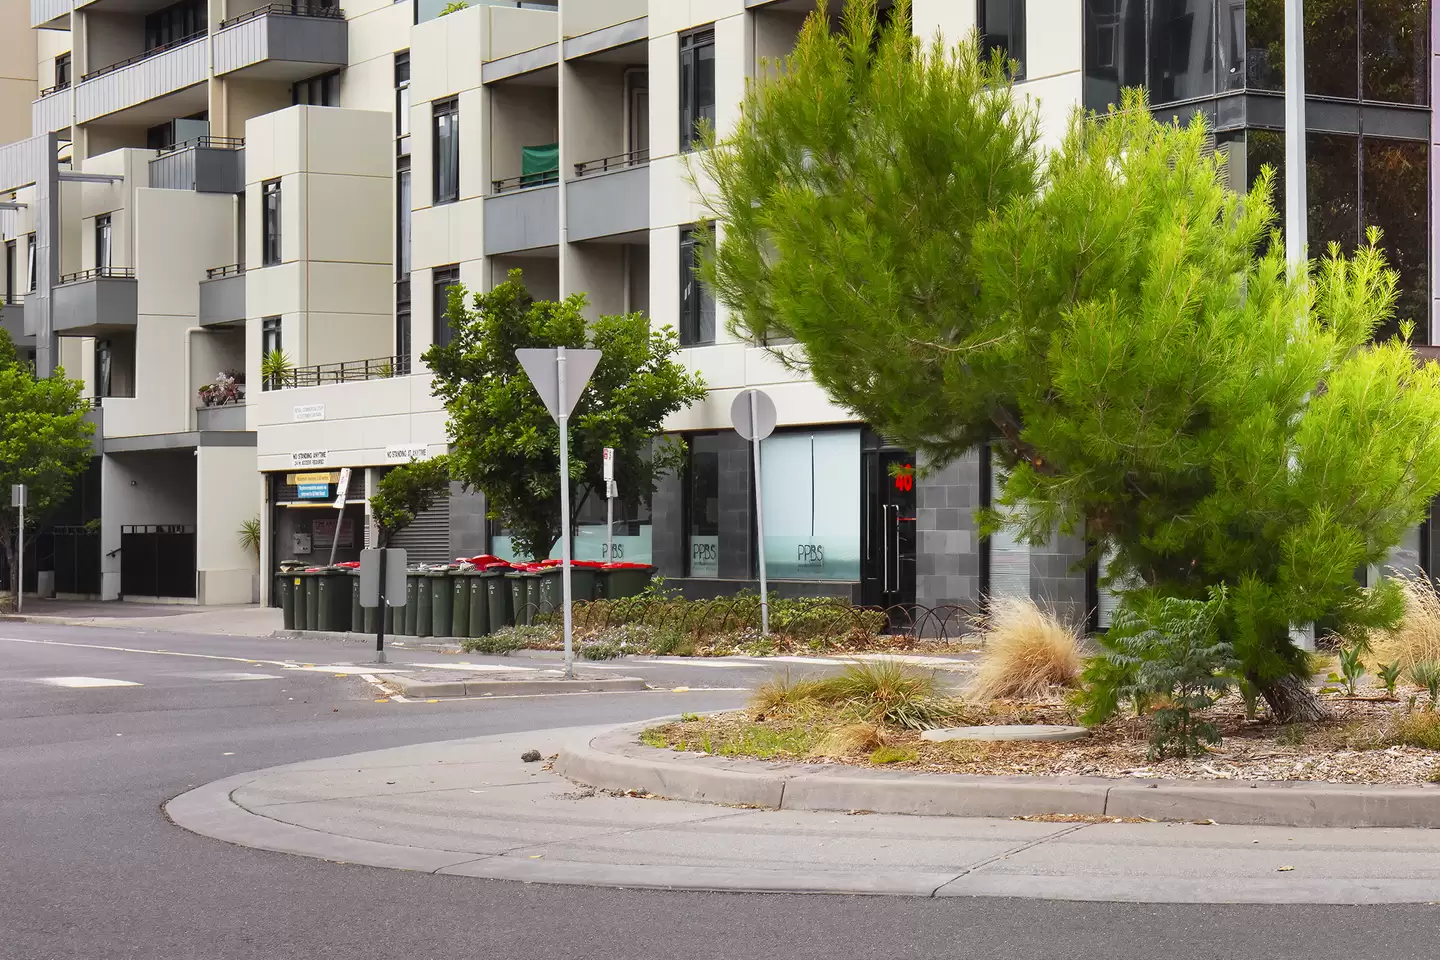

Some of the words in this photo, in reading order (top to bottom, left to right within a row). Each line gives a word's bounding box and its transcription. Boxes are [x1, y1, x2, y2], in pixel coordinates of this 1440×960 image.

[896, 464, 913, 491] 40
[602, 543, 623, 559] PBS
[693, 543, 717, 560] PPBS
[797, 544, 823, 562] PPBS
